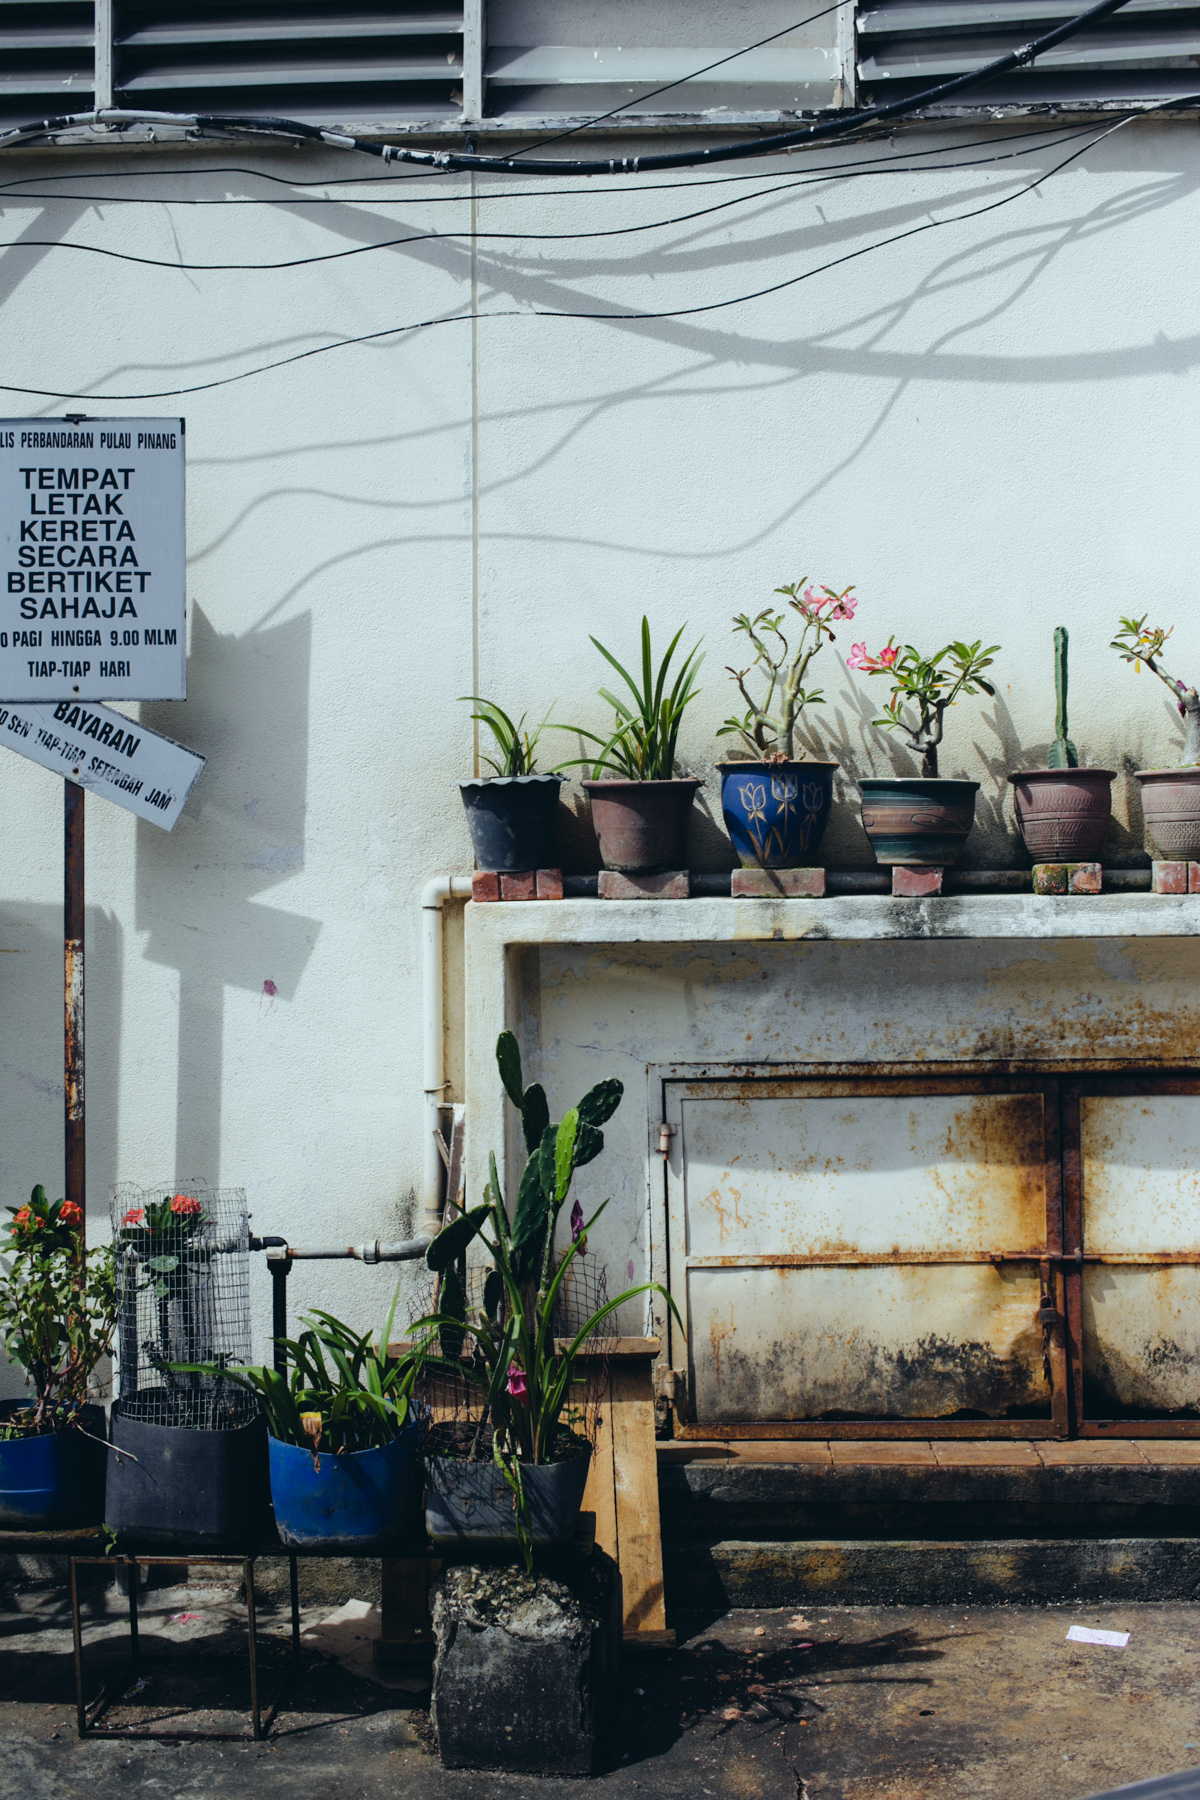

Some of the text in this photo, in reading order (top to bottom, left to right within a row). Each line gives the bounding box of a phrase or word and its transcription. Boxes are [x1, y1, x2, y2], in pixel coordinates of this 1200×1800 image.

[21, 432, 94, 449] PERBANDARAN
[100, 432, 131, 449] PULAU
[137, 433, 177, 449] PINANG
[19, 468, 135, 490] TEMPAT
[30, 493, 124, 515] LETAK
[20, 520, 136, 542] KERETA
[18, 545, 139, 568] SECARA
[7, 571, 152, 593] BERTIKET
[20, 596, 138, 620] SAHAJA
[12, 630, 43, 647] PAGI
[51, 630, 102, 647] HINGGA
[110, 630, 140, 647] 9.00
[144, 629, 177, 646] MLM
[27, 661, 131, 677] TIAP-TIAP HARI
[53, 702, 141, 758] BAYARAN
[7, 714, 33, 738] SEN
[88, 756, 144, 797] SETENGAH
[144, 788, 173, 811] JAM
